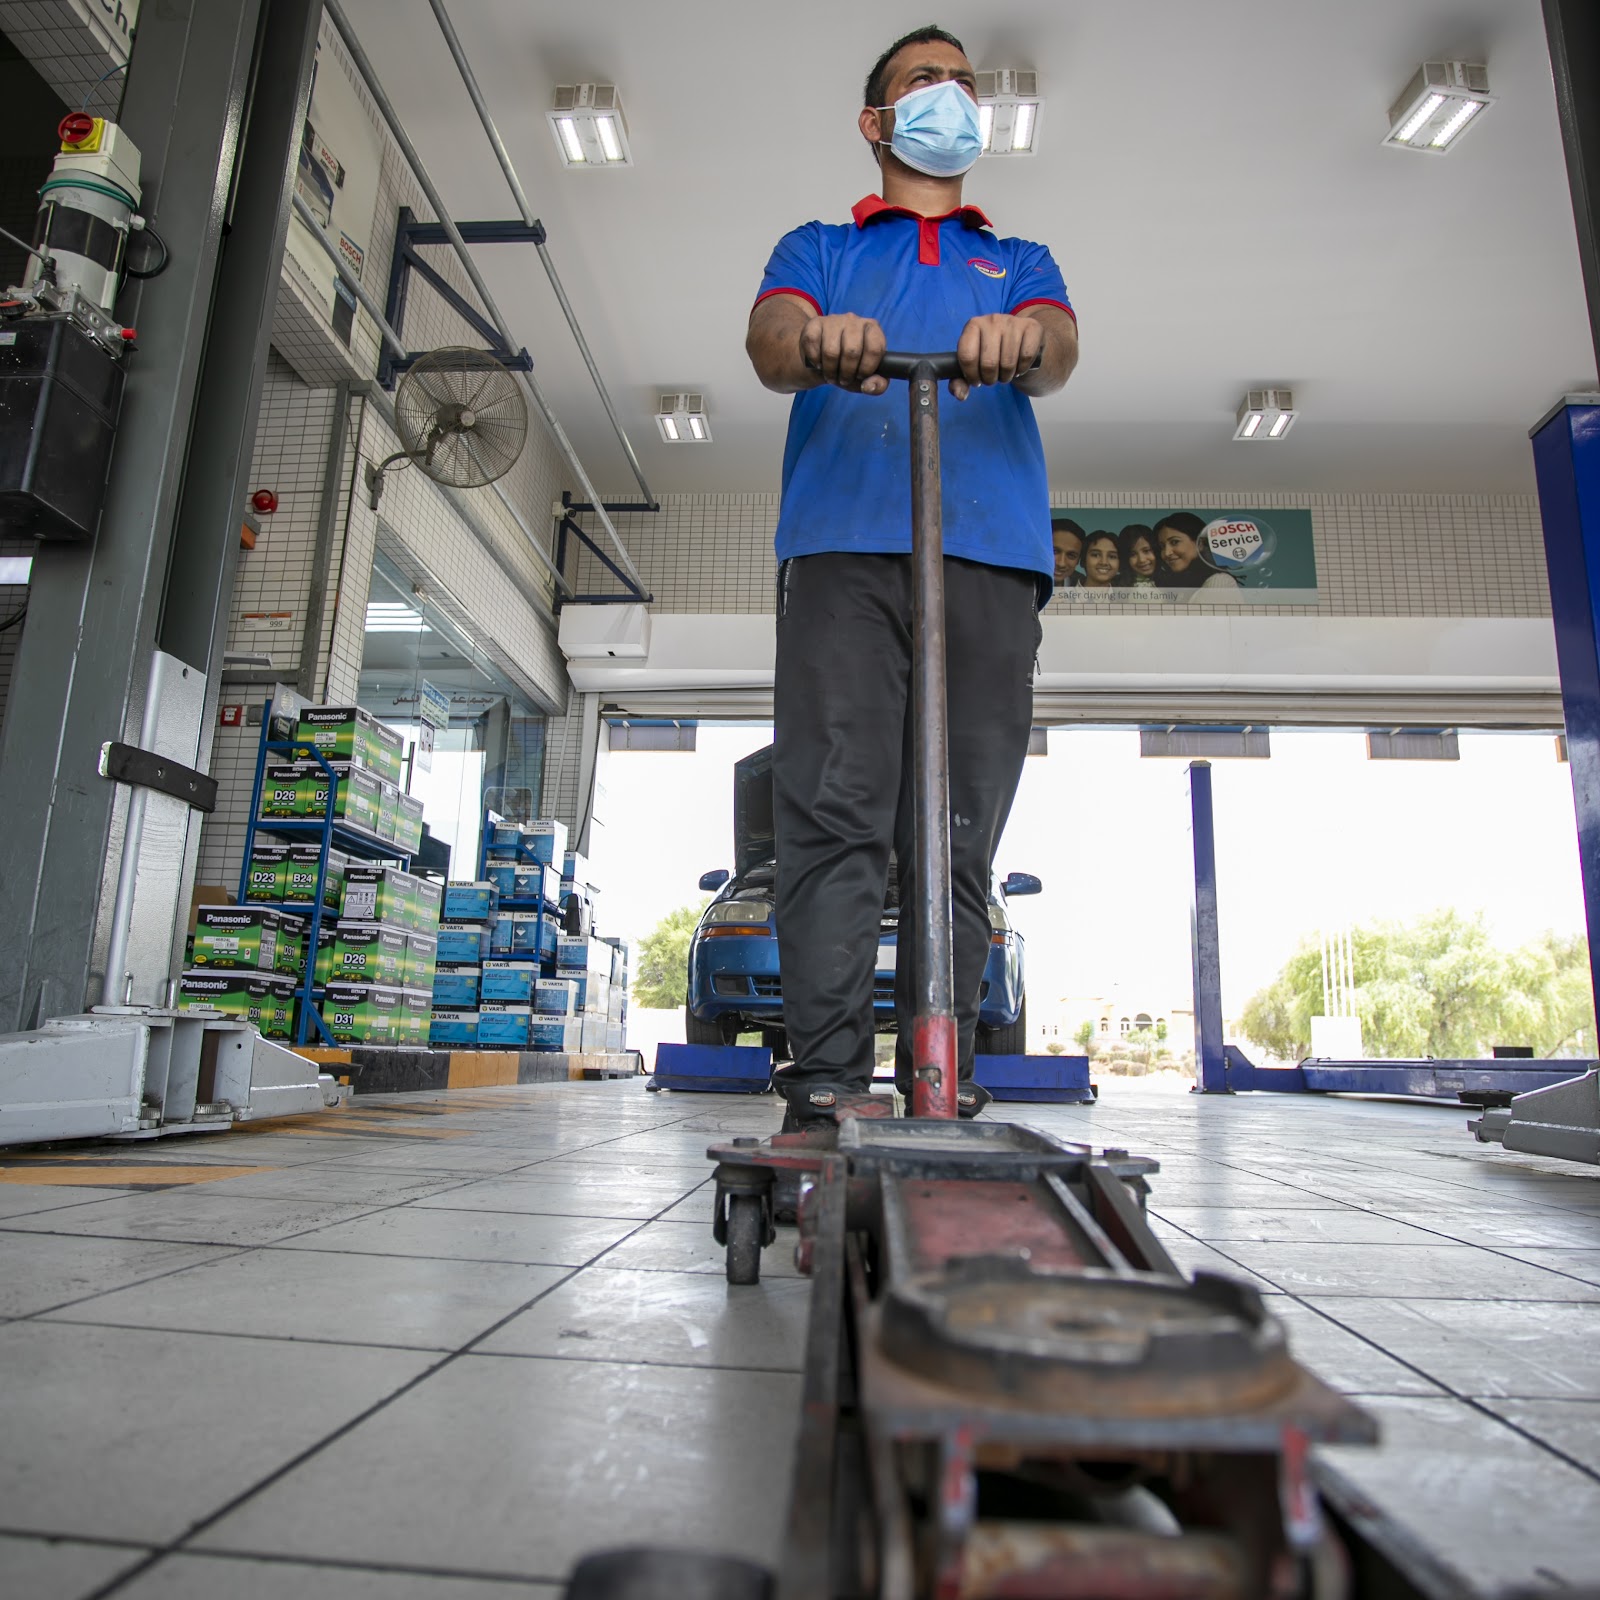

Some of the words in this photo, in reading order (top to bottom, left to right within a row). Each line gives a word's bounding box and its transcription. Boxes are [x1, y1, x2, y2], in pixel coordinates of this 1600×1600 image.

[321, 148, 337, 172] BOSCH
[340, 237, 362, 264] BOSCH
[339, 248, 360, 275] Service
[1210, 523, 1256, 537] BOSCH
[1211, 534, 1260, 549] Service
[1058, 591, 1081, 600] safer
[1084, 591, 1115, 601] driving
[1118, 591, 1130, 600] for
[1132, 591, 1148, 600] the
[1150, 591, 1178, 601] family
[308, 713, 348, 721] Panasonic
[377, 727, 397, 745] Panasonic
[354, 773, 375, 789] Panasonic
[274, 790, 296, 801] D26
[403, 799, 420, 812] Panasonic
[254, 872, 275, 883] D23
[293, 874, 313, 883] B24
[392, 875, 412, 889] Panasonic
[421, 886, 438, 898] Panasonic
[207, 914, 251, 923] Panasonic
[263, 919, 277, 927] Panasonic
[284, 924, 299, 933] Panasonic
[383, 934, 402, 945] Panasonic
[284, 945, 295, 956] D31
[413, 941, 432, 952] Panasonic
[344, 953, 366, 964] D26
[180, 979, 228, 990] Panasonic
[249, 985, 266, 993] Panasonic
[332, 993, 360, 1001] Panasonic
[375, 994, 395, 1004] Panasonic
[409, 998, 426, 1007] Panasonic
[249, 1007, 261, 1018] D31
[274, 1009, 286, 1020] D31
[335, 1014, 354, 1024] D31
